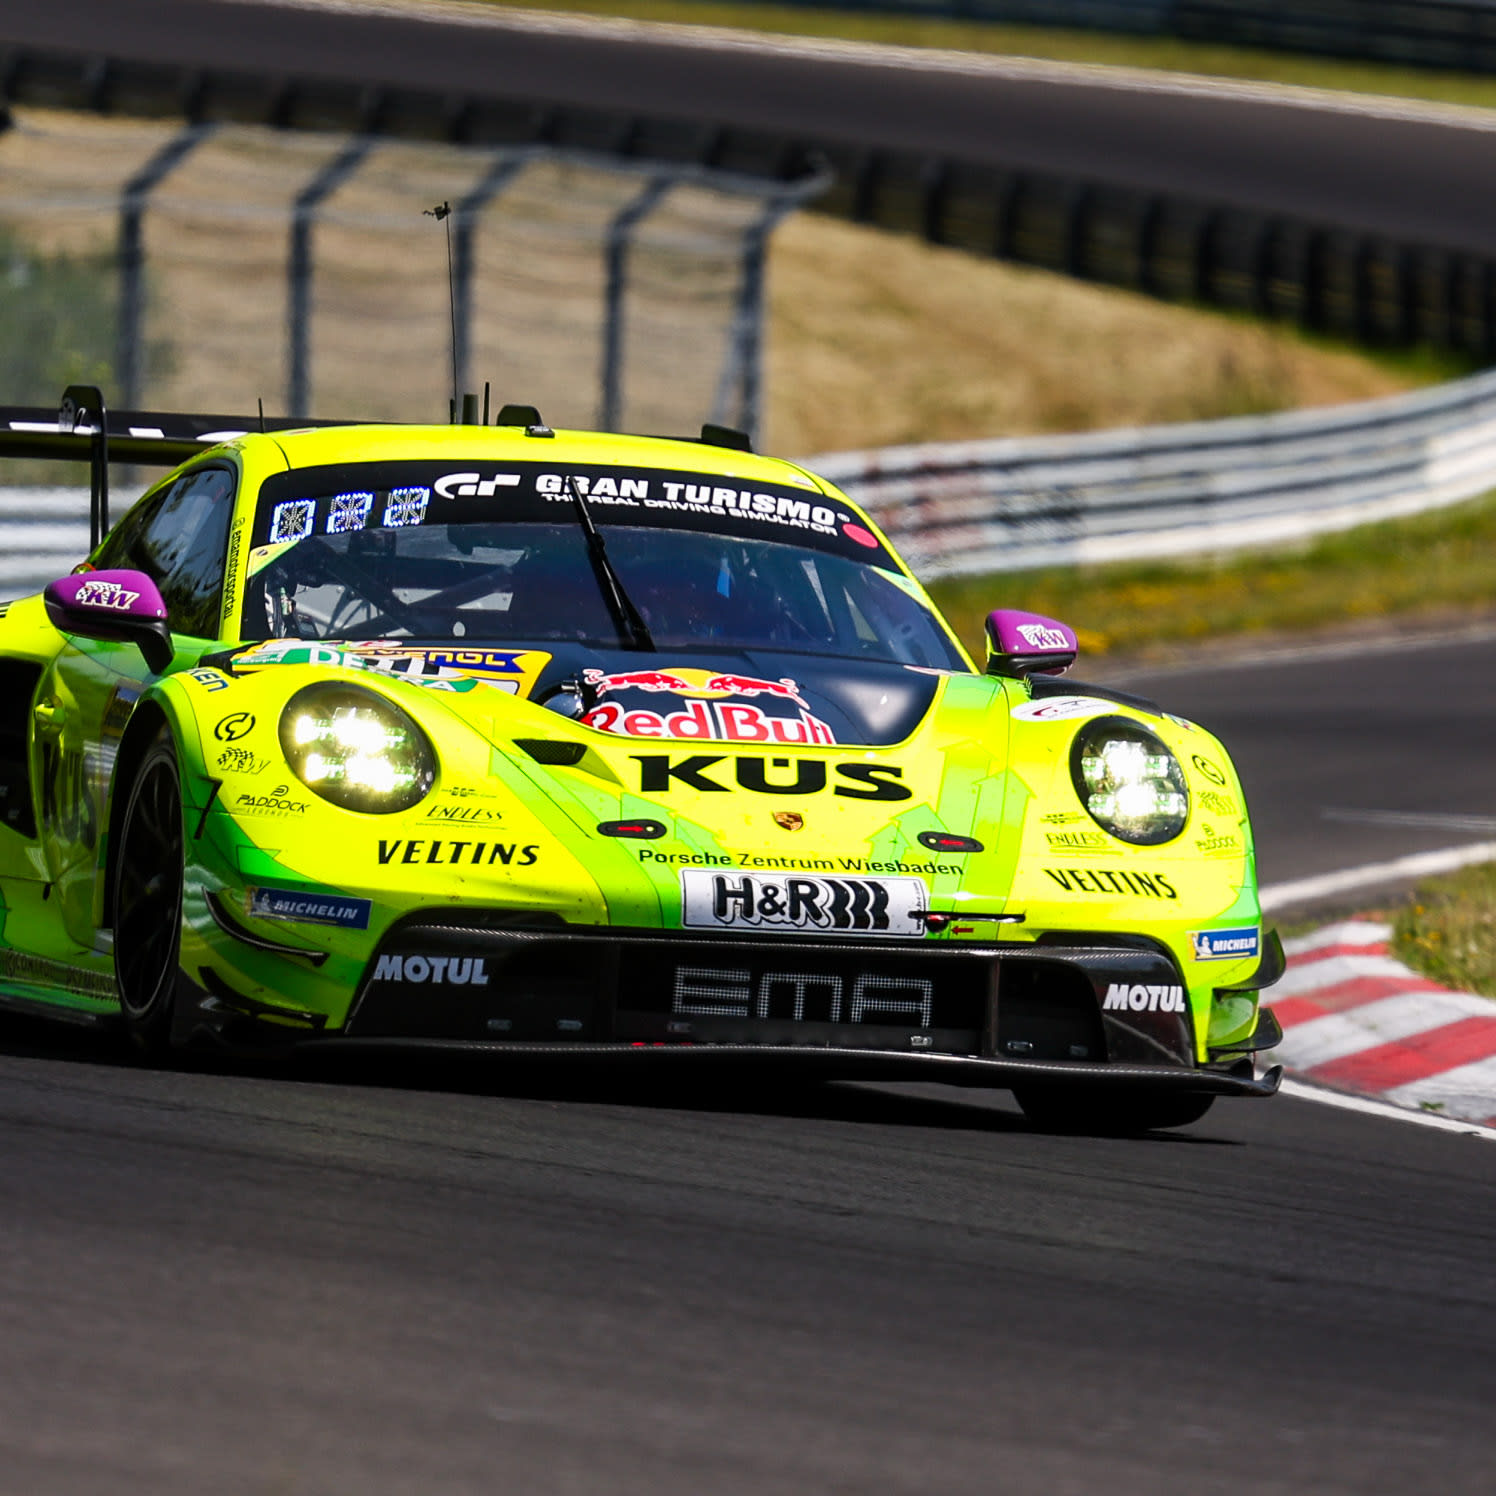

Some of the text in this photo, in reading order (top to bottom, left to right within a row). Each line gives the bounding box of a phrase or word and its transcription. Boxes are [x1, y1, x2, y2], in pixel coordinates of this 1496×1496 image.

[536, 474, 649, 499] GRAN
[587, 495, 641, 507] REAL
[643, 499, 727, 516] DRIVING
[728, 507, 839, 537] SIMULATOR
[81, 584, 140, 609] KW
[582, 699, 837, 746] Red Bull
[628, 755, 913, 802] KÜS
[236, 794, 311, 813] PADDOCK
[426, 805, 505, 820] ENDLESS
[377, 839, 540, 866] VELTINS
[639, 849, 964, 876] Porsche Zentrum Wiesbaden
[1044, 868, 1177, 900] VELTINS
[273, 899, 359, 920] MICHELIN
[712, 875, 831, 928] H&R
[1212, 937, 1257, 952] MICHELIN
[373, 954, 490, 985] MOTUL
[672, 966, 934, 1029] EMA
[1103, 983, 1186, 1013] MOTUL
